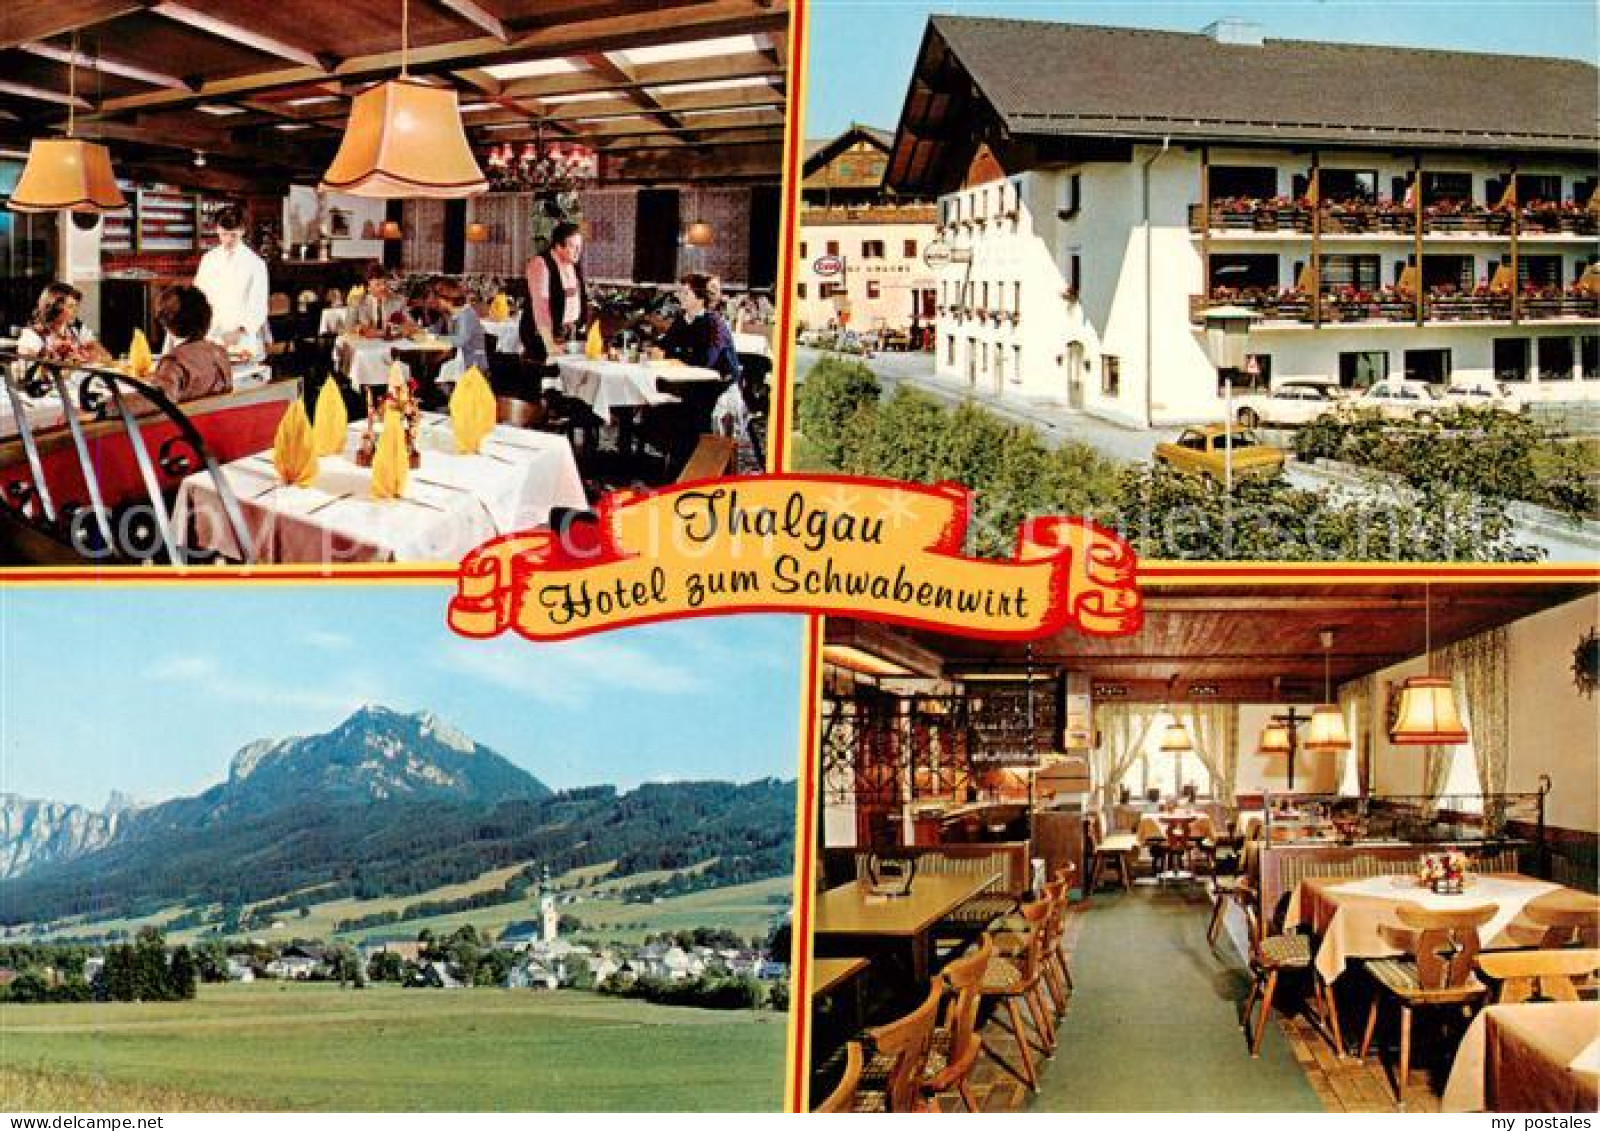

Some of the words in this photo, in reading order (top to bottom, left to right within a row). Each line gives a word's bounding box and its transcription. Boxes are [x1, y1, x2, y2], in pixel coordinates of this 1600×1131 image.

[673, 488, 885, 552] Thalgau
[538, 566, 667, 625] Hotel
[685, 572, 761, 607] zum
[772, 554, 1028, 619] Schwabenwirt
